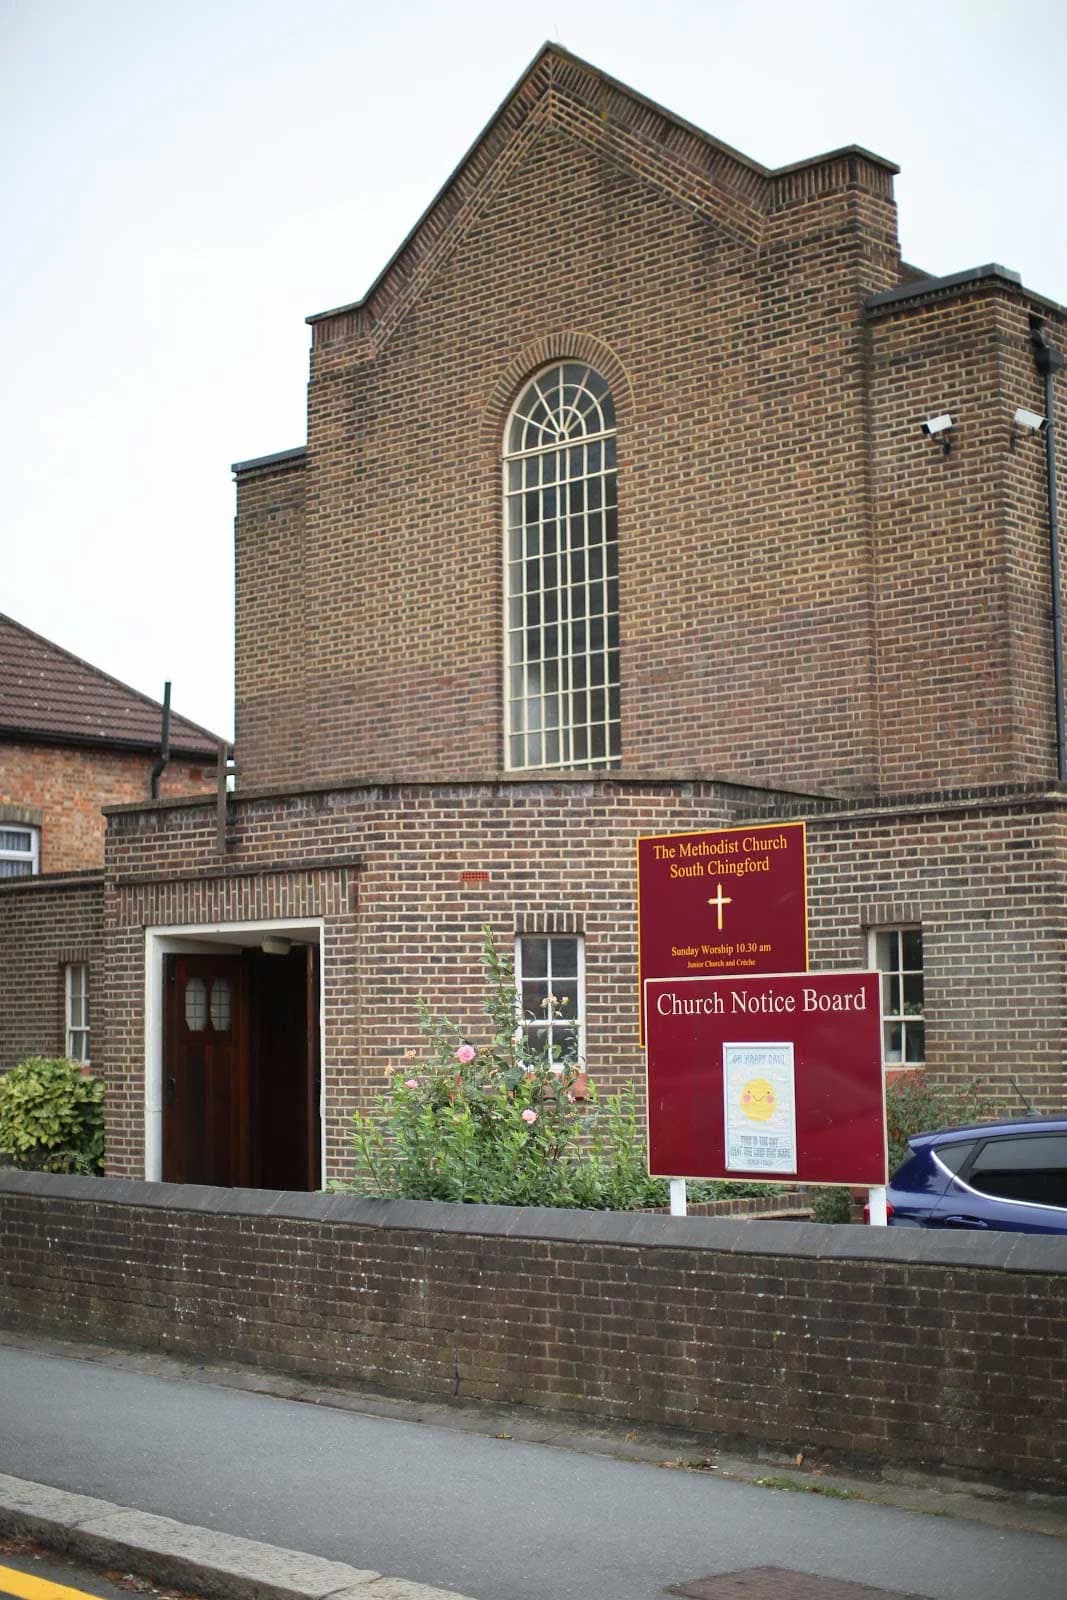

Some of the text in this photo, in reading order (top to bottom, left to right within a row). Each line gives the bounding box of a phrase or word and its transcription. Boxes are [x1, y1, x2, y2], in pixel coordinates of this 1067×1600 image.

[653, 834, 788, 859] The Methodist Church
[670, 856, 770, 878] South Chingford
[671, 946, 699, 958] Sunday
[701, 944, 734, 956] Worship
[736, 942, 758, 952] 10.30
[704, 960, 724, 968] Church
[656, 986, 867, 1016] Church Notice Board
